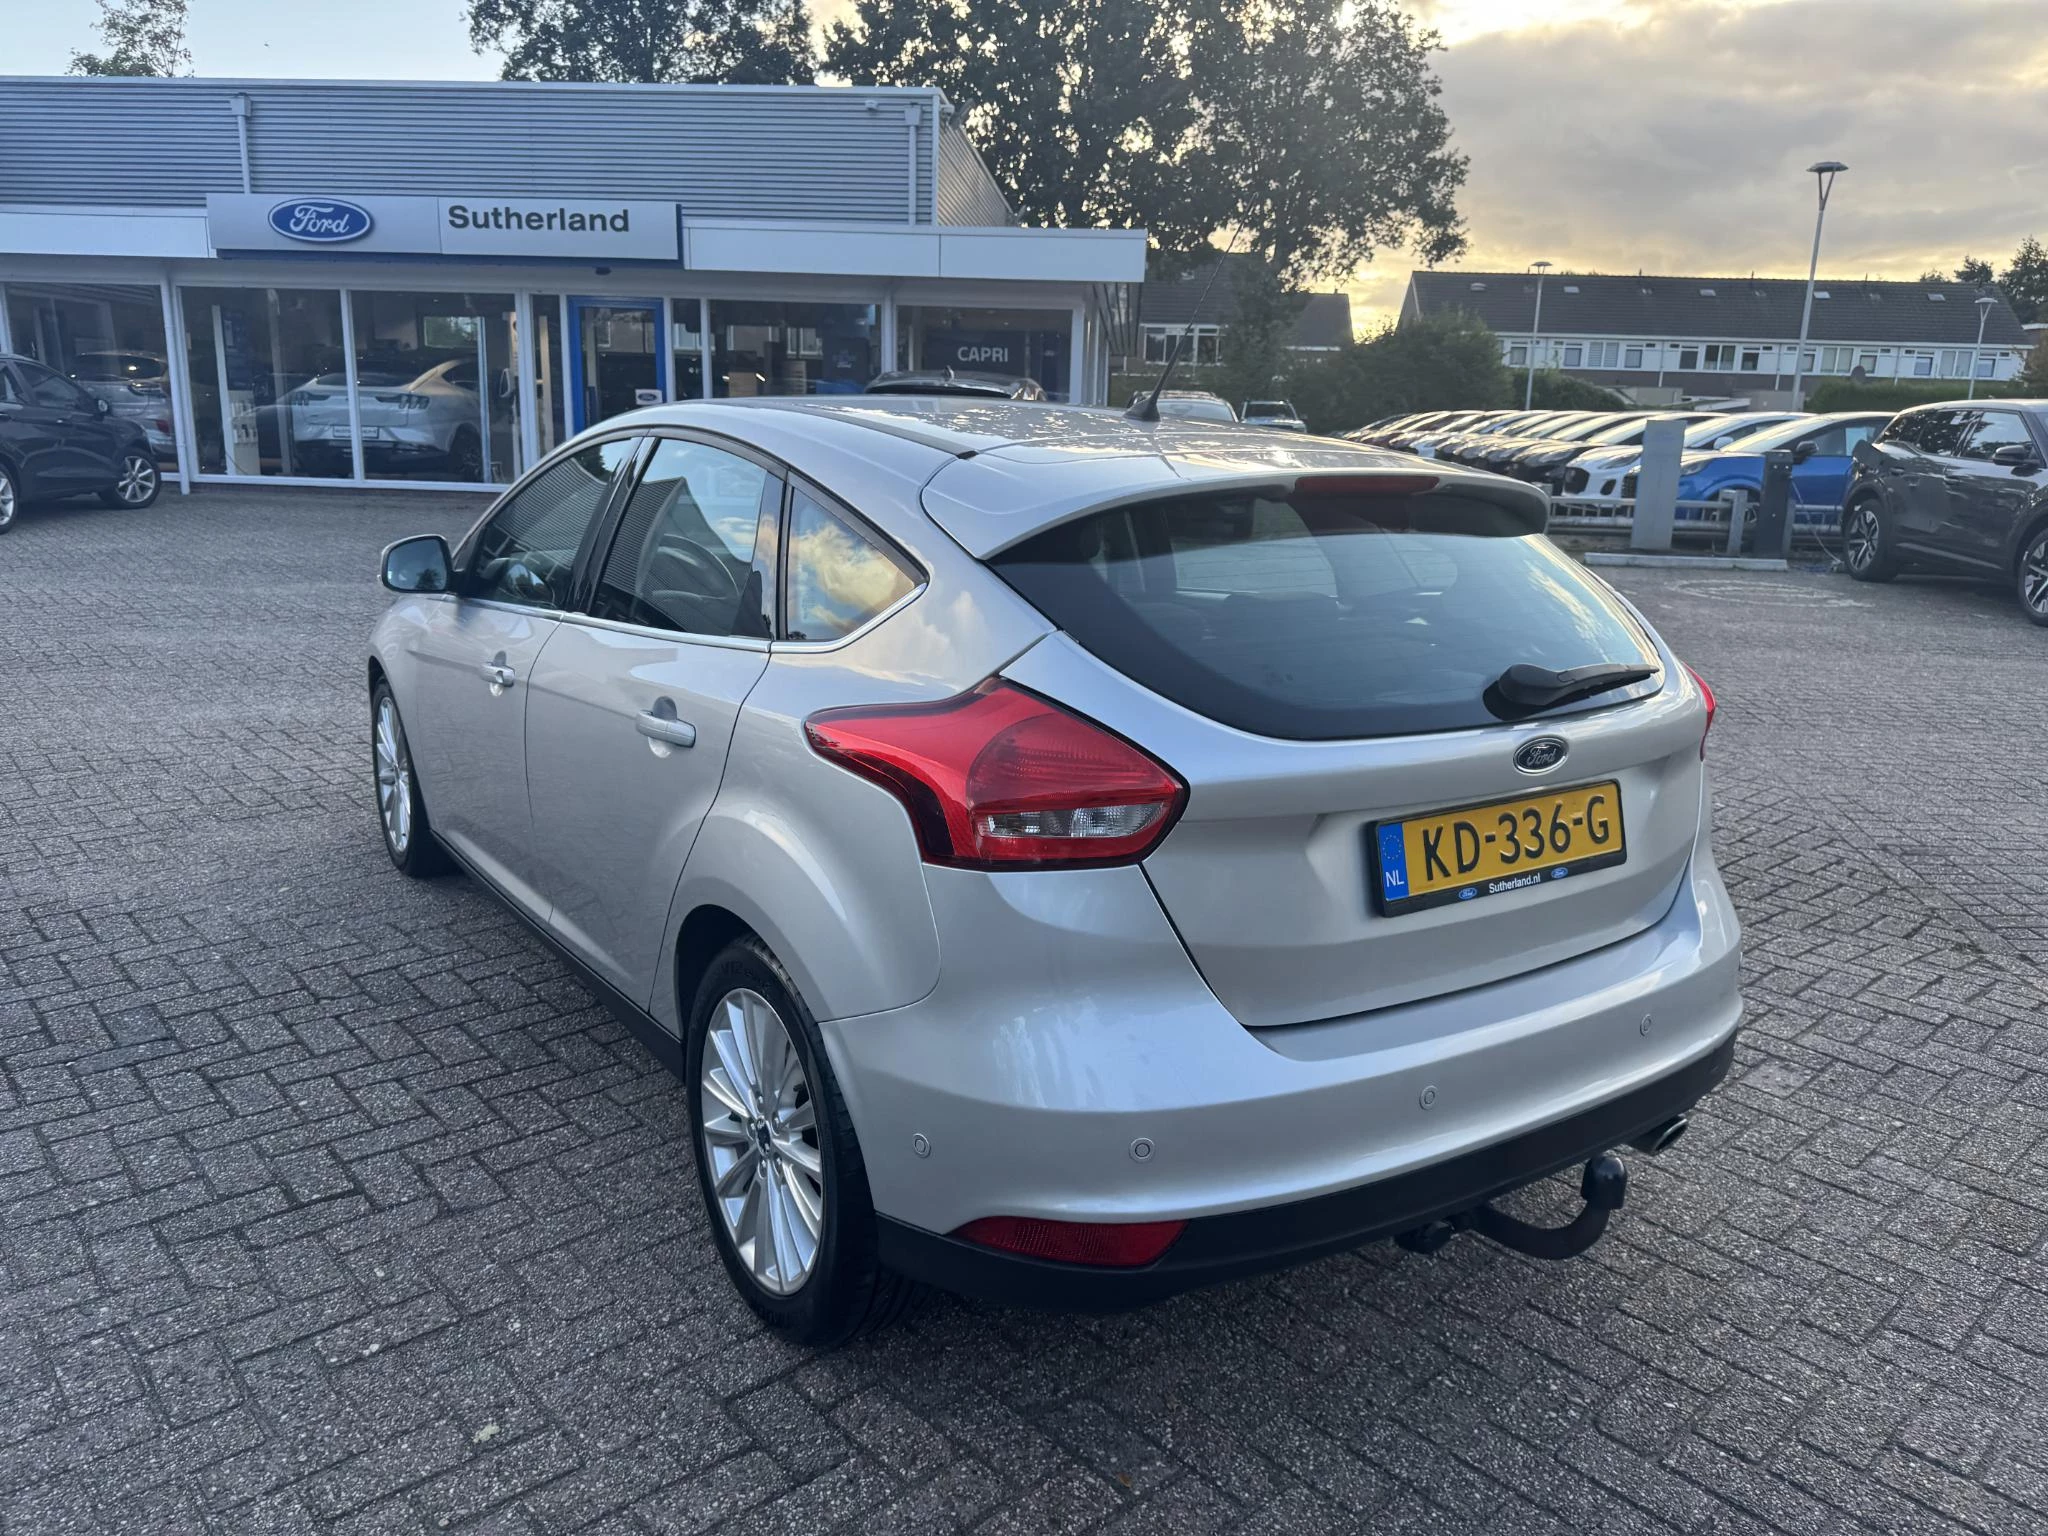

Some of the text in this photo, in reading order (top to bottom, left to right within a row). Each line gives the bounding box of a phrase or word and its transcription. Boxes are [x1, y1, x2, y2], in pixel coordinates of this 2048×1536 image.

[289, 205, 350, 233] Ford
[448, 204, 630, 232] Sutherland
[957, 346, 1009, 363] CAPRI
[1526, 745, 1557, 766] Ford
[1422, 795, 1610, 881] KD-336-G
[1385, 869, 1405, 888] NL
[1488, 872, 1541, 894] Sutherland.nl
